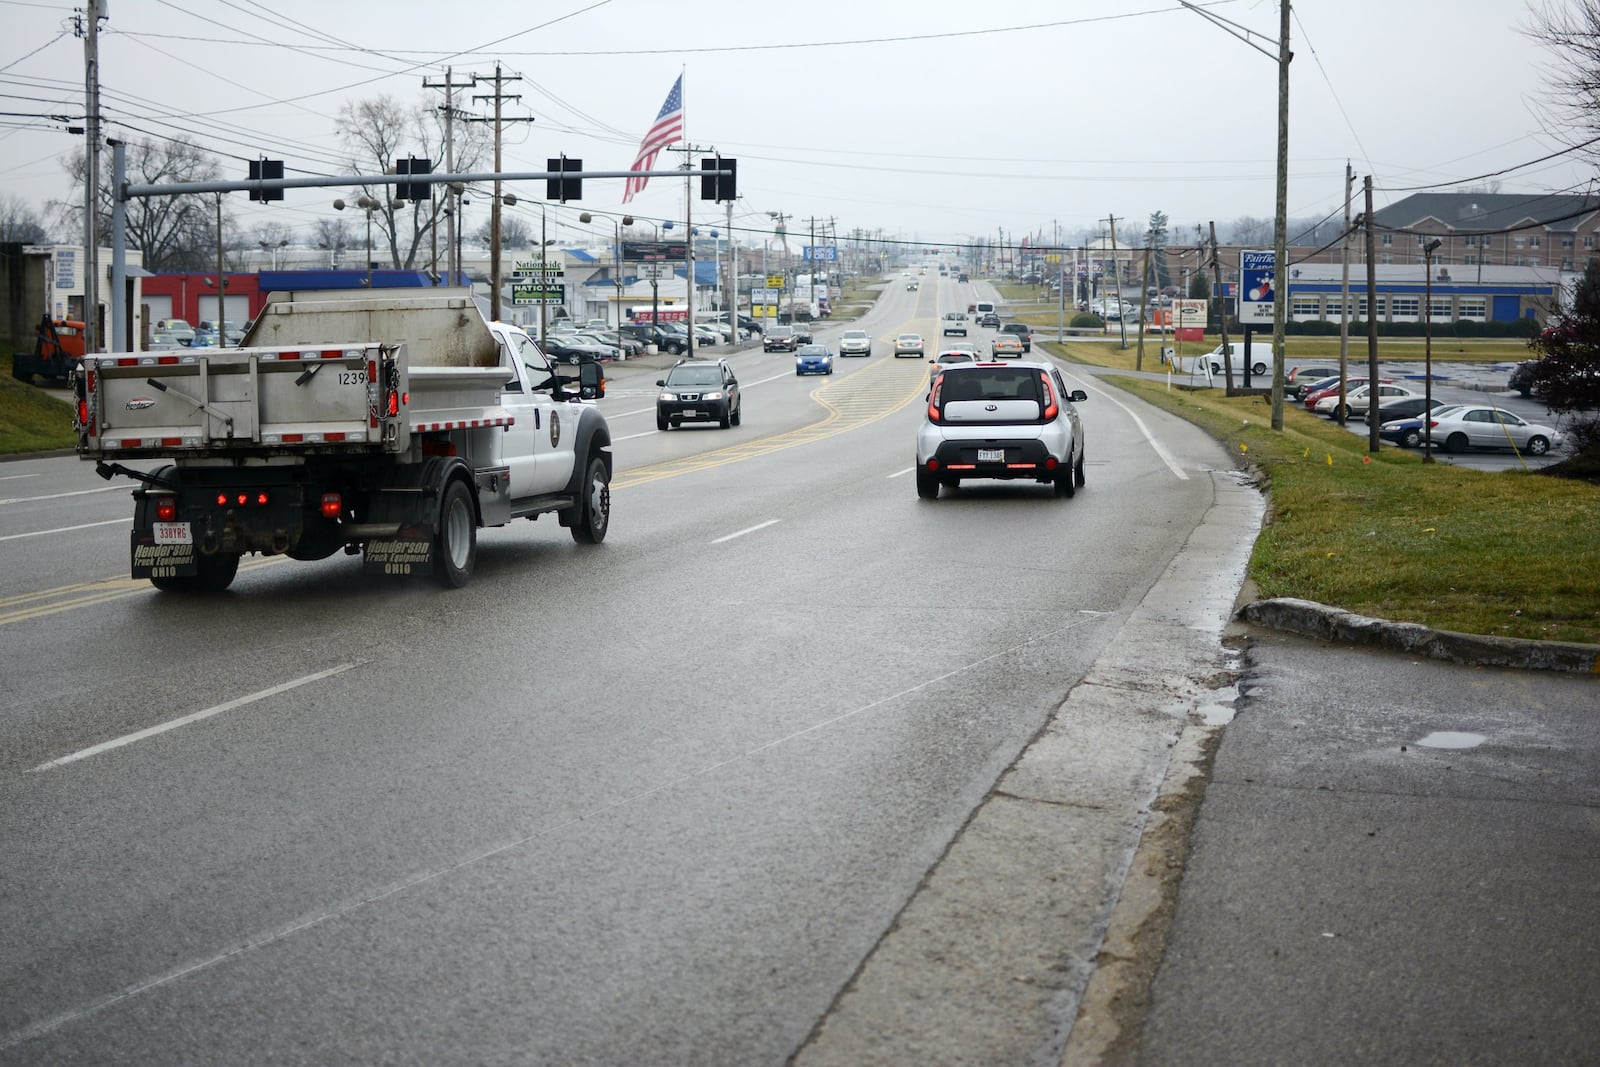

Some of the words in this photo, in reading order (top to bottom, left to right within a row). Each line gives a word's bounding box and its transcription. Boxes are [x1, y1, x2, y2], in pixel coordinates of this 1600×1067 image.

[1244, 254, 1277, 263] Fairfie
[338, 372, 365, 385] 1239
[134, 543, 193, 558] Henderson
[367, 540, 430, 553] Henderson
[134, 557, 155, 567] Truck
[156, 555, 194, 567] Equipment
[366, 552, 388, 562] Truck
[390, 553, 430, 564] Equipment
[152, 566, 176, 578] OHIO
[384, 563, 411, 574] OHIO
